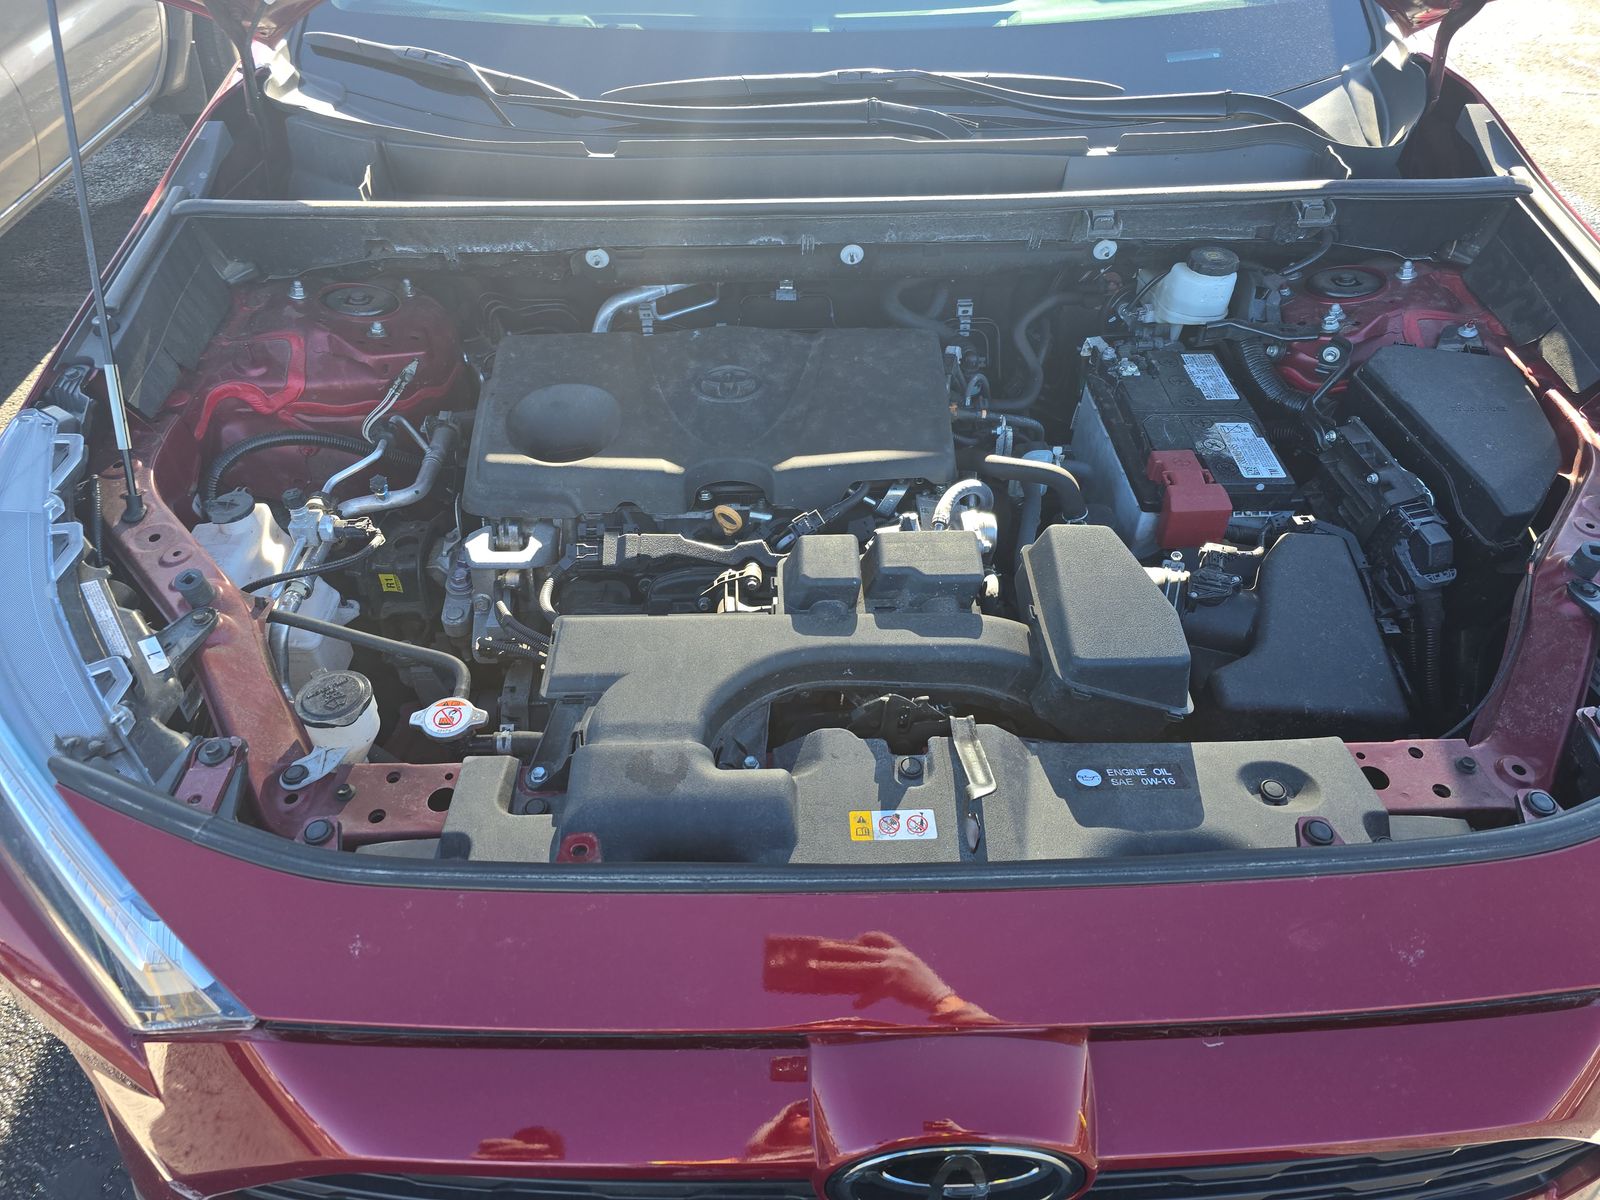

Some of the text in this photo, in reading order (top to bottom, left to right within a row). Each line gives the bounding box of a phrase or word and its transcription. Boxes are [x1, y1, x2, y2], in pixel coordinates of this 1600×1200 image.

[384, 578, 396, 588] R1
[1106, 768, 1172, 777] ENGINE OIL
[1111, 777, 1176, 786] SAE 0W-16
